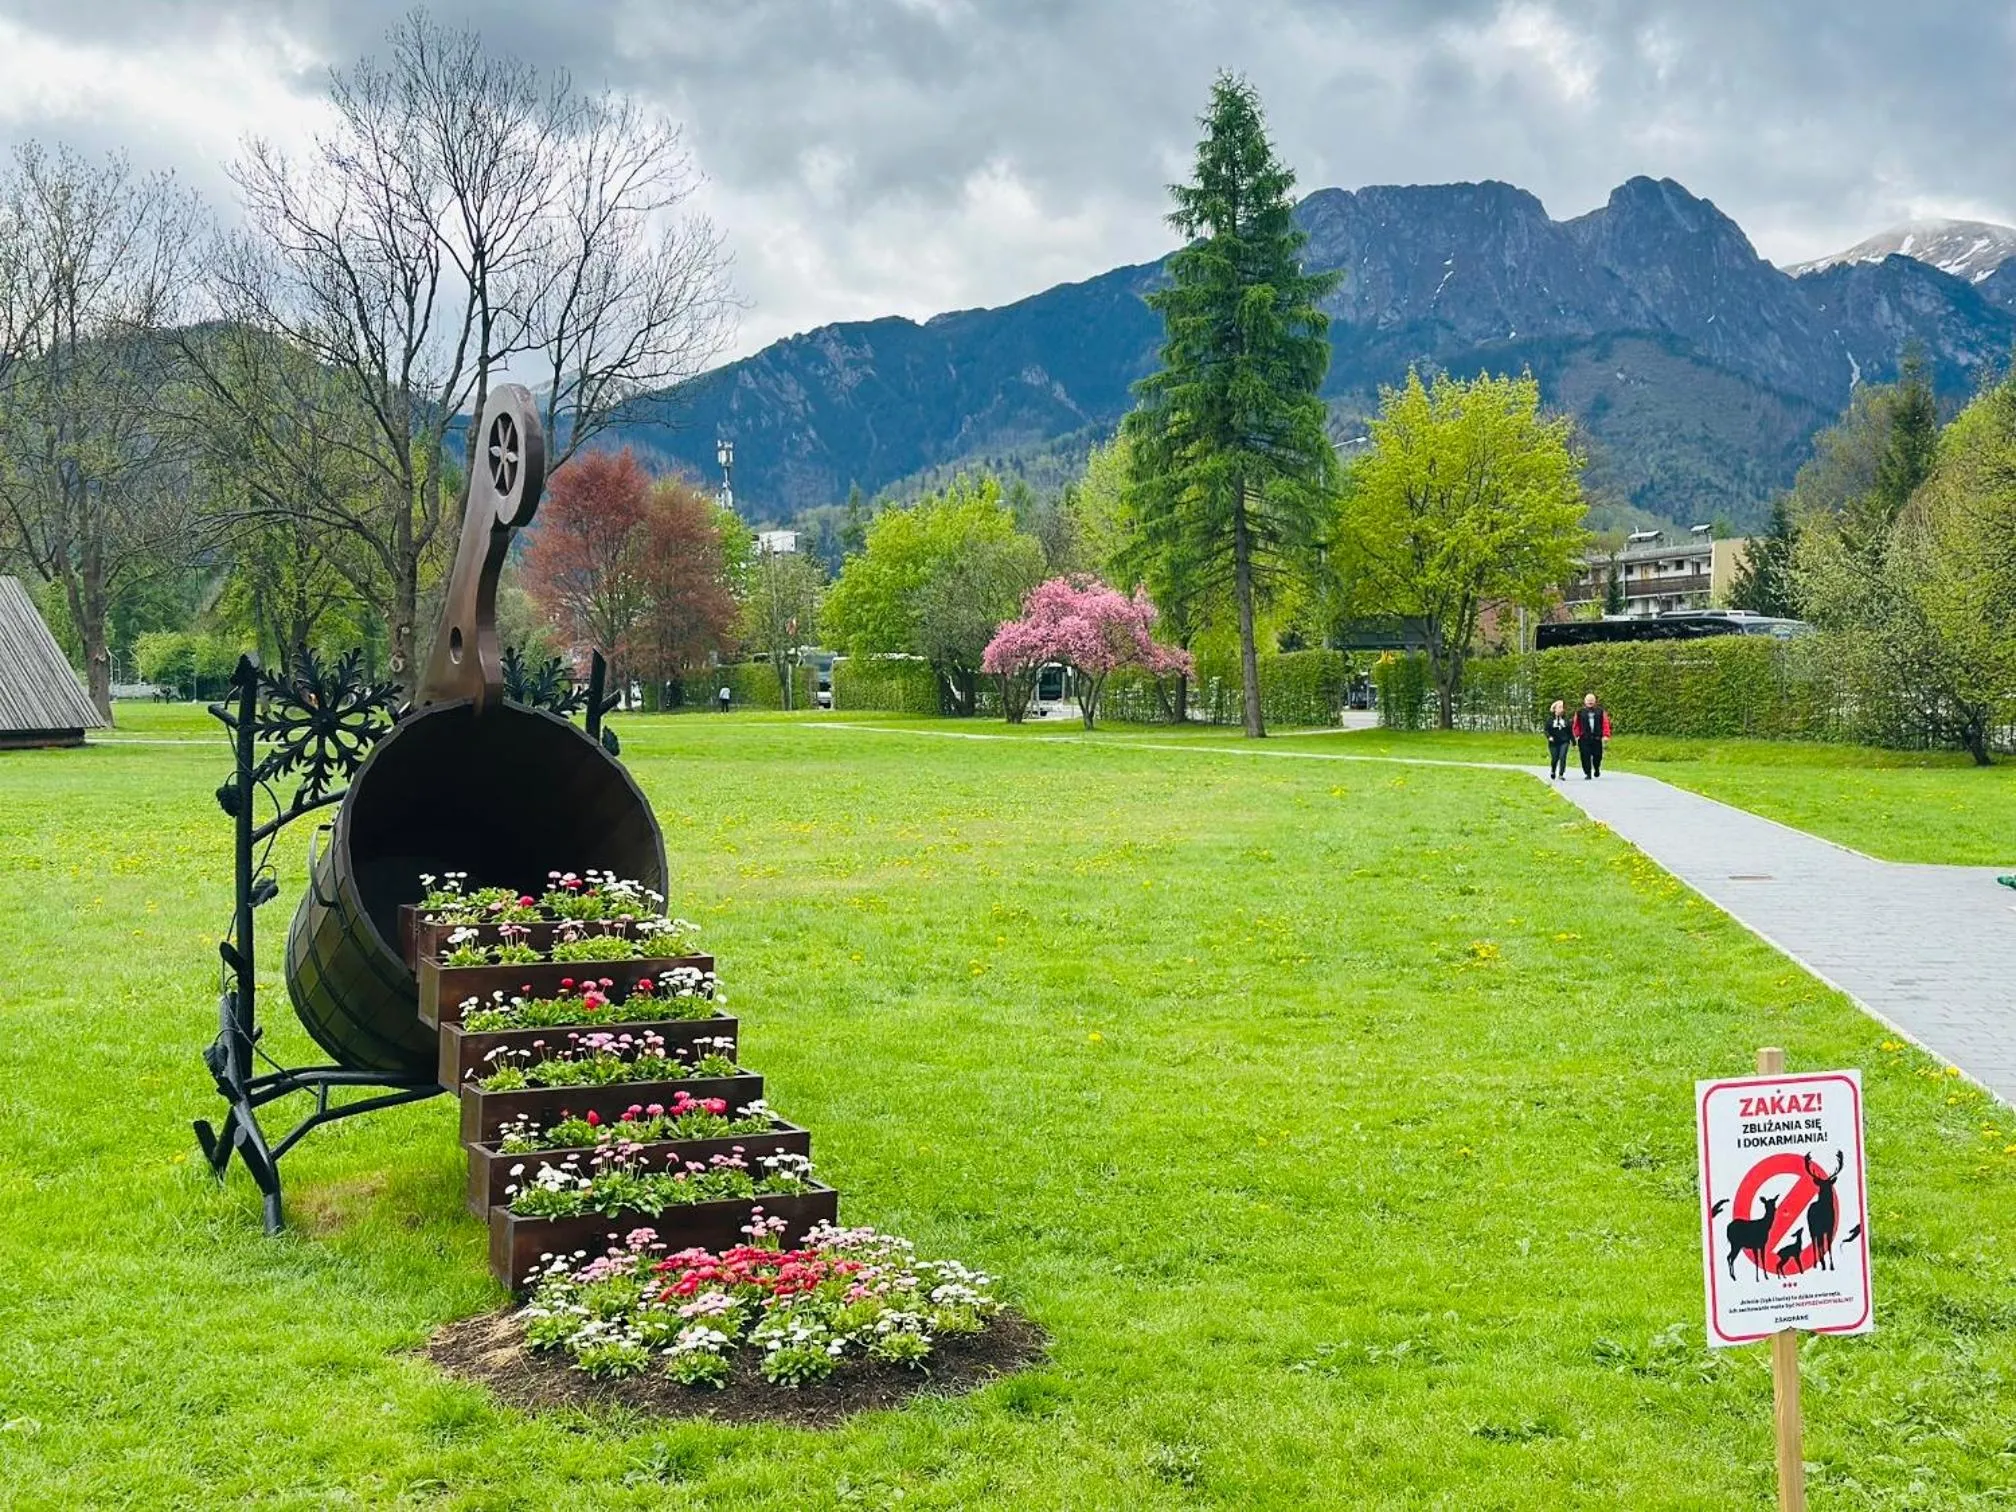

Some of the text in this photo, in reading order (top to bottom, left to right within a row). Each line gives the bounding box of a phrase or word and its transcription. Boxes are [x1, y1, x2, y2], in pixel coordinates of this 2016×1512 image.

[1739, 1092, 1822, 1117] ZAKAZ!
[1742, 1118, 1822, 1134] ZBLIŻANIA SIĘ
[1737, 1132, 1828, 1148] I DOKARMIANIA!
